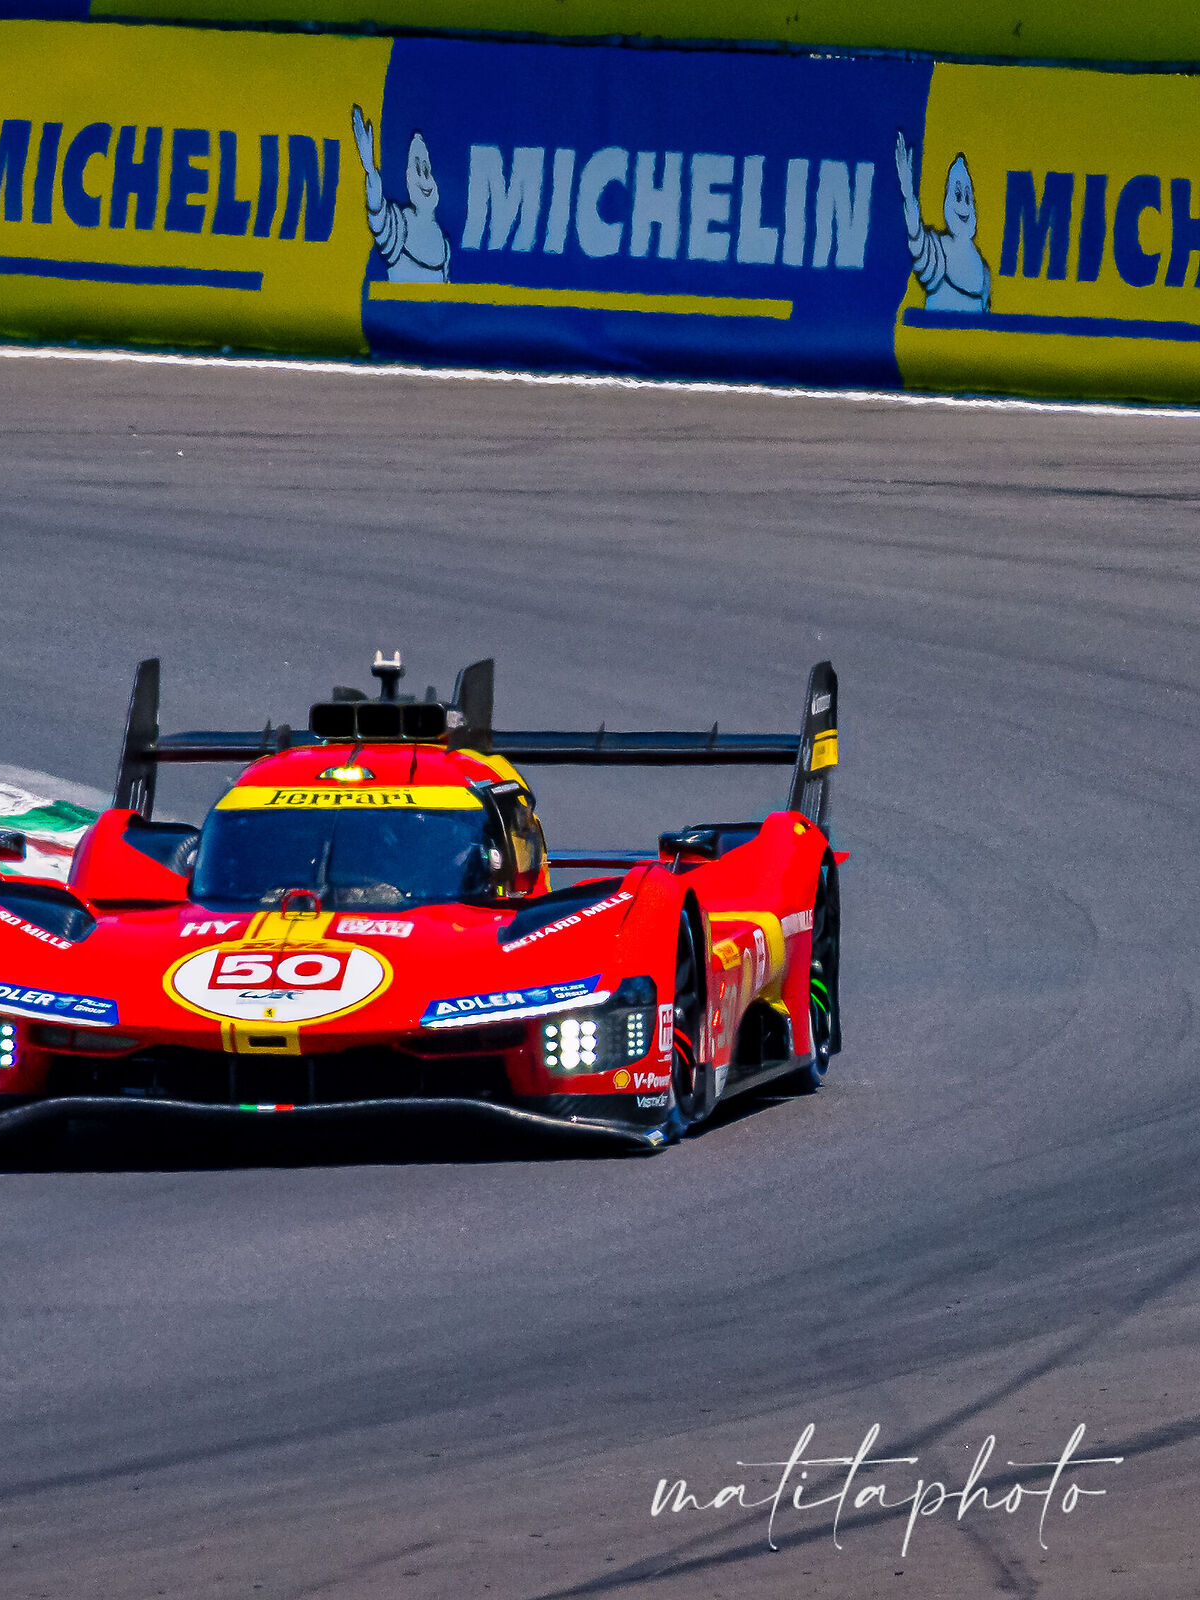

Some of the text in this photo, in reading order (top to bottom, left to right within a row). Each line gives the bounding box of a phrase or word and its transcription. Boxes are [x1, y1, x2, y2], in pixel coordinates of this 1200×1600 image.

[461, 144, 874, 270] MICHELIN
[264, 789, 417, 806] Ferrari
[180, 920, 241, 937] HY
[502, 892, 633, 952] RICHARD MILLE
[20, 924, 73, 950] MILLE
[216, 954, 340, 985] 50
[436, 992, 526, 1016] ADLER
